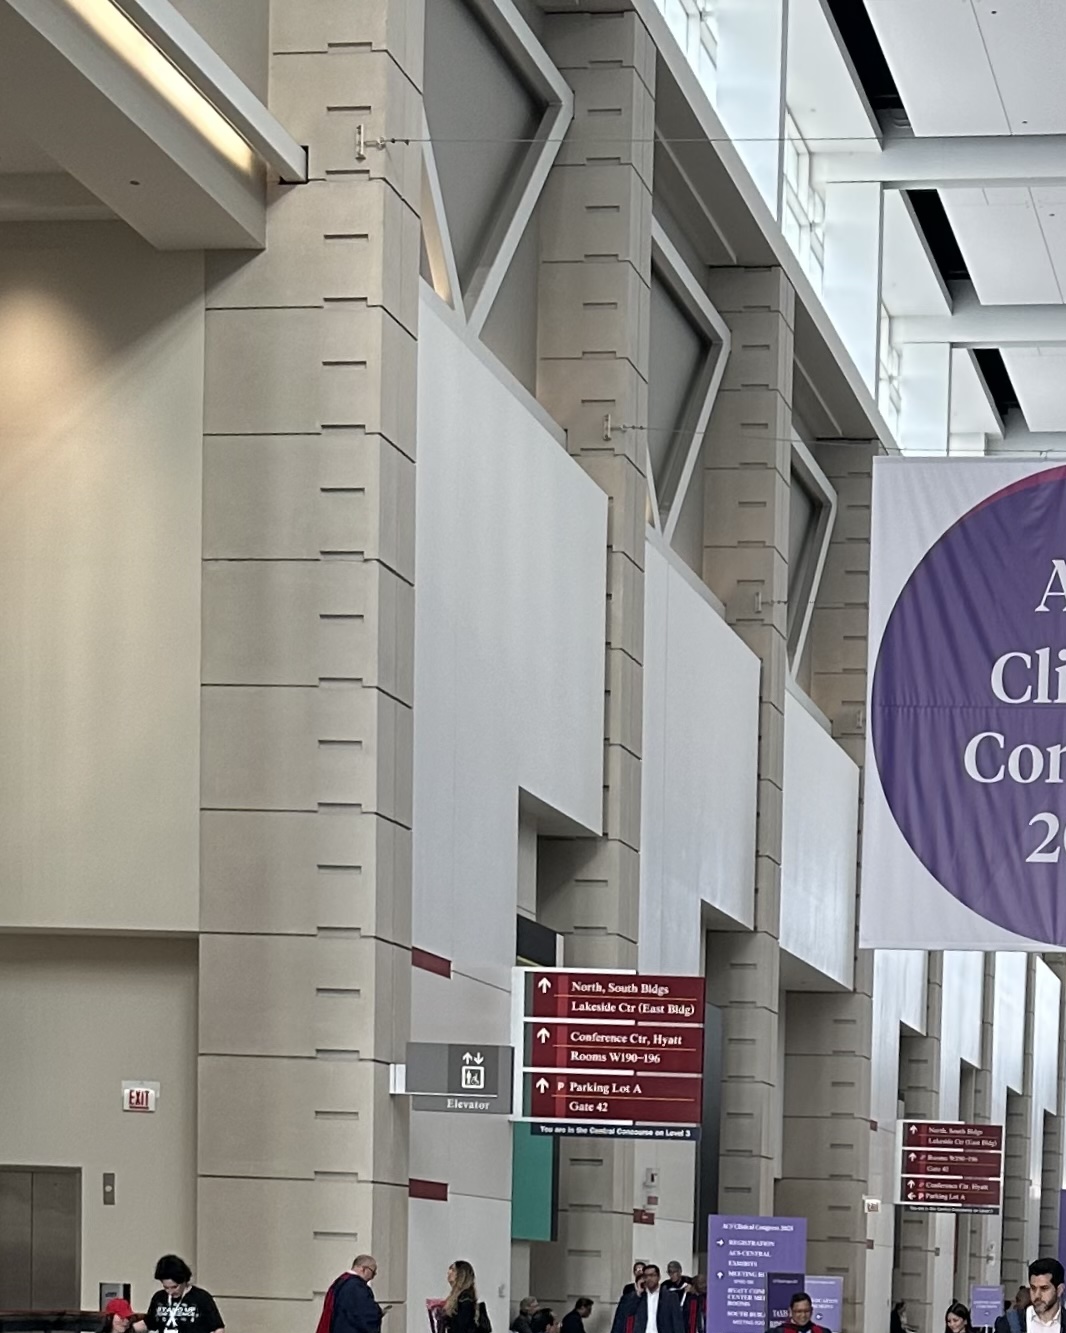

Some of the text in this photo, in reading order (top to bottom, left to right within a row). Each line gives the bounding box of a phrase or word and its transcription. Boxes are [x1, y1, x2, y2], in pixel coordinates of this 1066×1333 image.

[571, 982, 669, 996] North, South Bldgs
[572, 1002, 694, 1016] Lakeside Ctr (East Bldg)
[571, 1032, 682, 1046] Conference Ctr, Hyatt
[571, 1051, 606, 1061] Rooms
[570, 1082, 609, 1094] Parking
[612, 1083, 630, 1093] Lot
[634, 1084, 642, 1093] A
[130, 1090, 149, 1106] EXIT
[447, 1099, 490, 1109] Elevator
[569, 1102, 608, 1112] Gate 42
